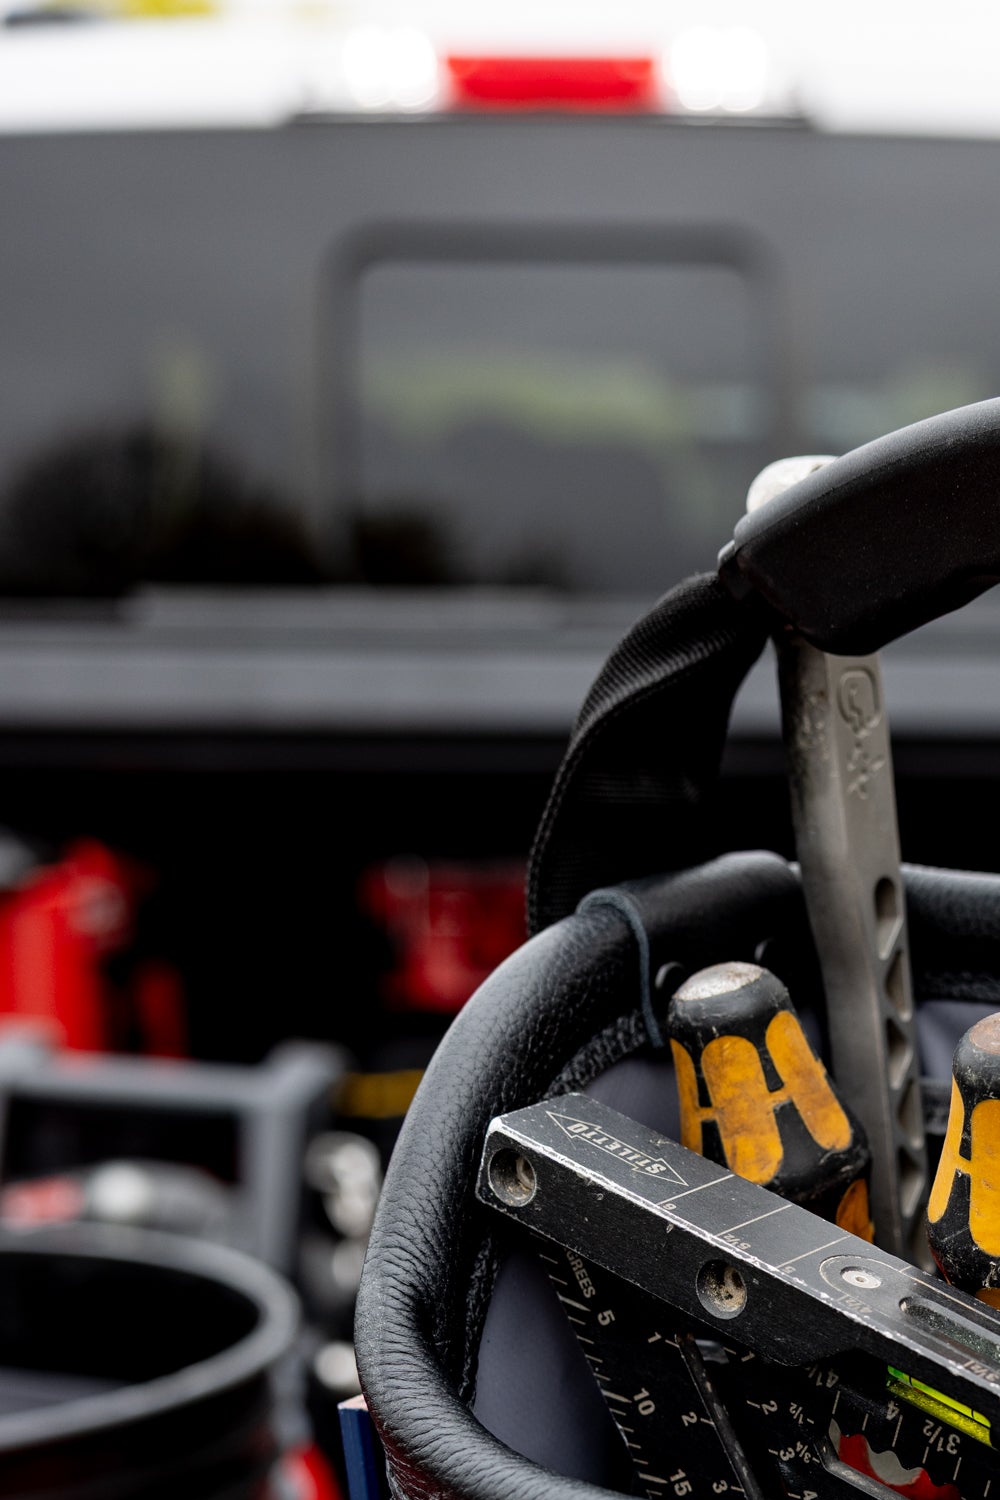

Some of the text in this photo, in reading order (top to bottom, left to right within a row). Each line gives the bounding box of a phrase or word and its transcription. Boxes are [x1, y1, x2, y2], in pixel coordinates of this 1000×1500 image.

[566, 1122, 667, 1175] STILETTO
[597, 1309, 616, 1326] 5
[633, 1387, 656, 1416] 10
[669, 1469, 692, 1497] 15
[647, 1331, 729, 1494] 1 2 3
[741, 1351, 755, 1363] 1
[761, 1400, 778, 1415] 2
[779, 1447, 795, 1461] 3
[885, 1400, 900, 1421] 4
